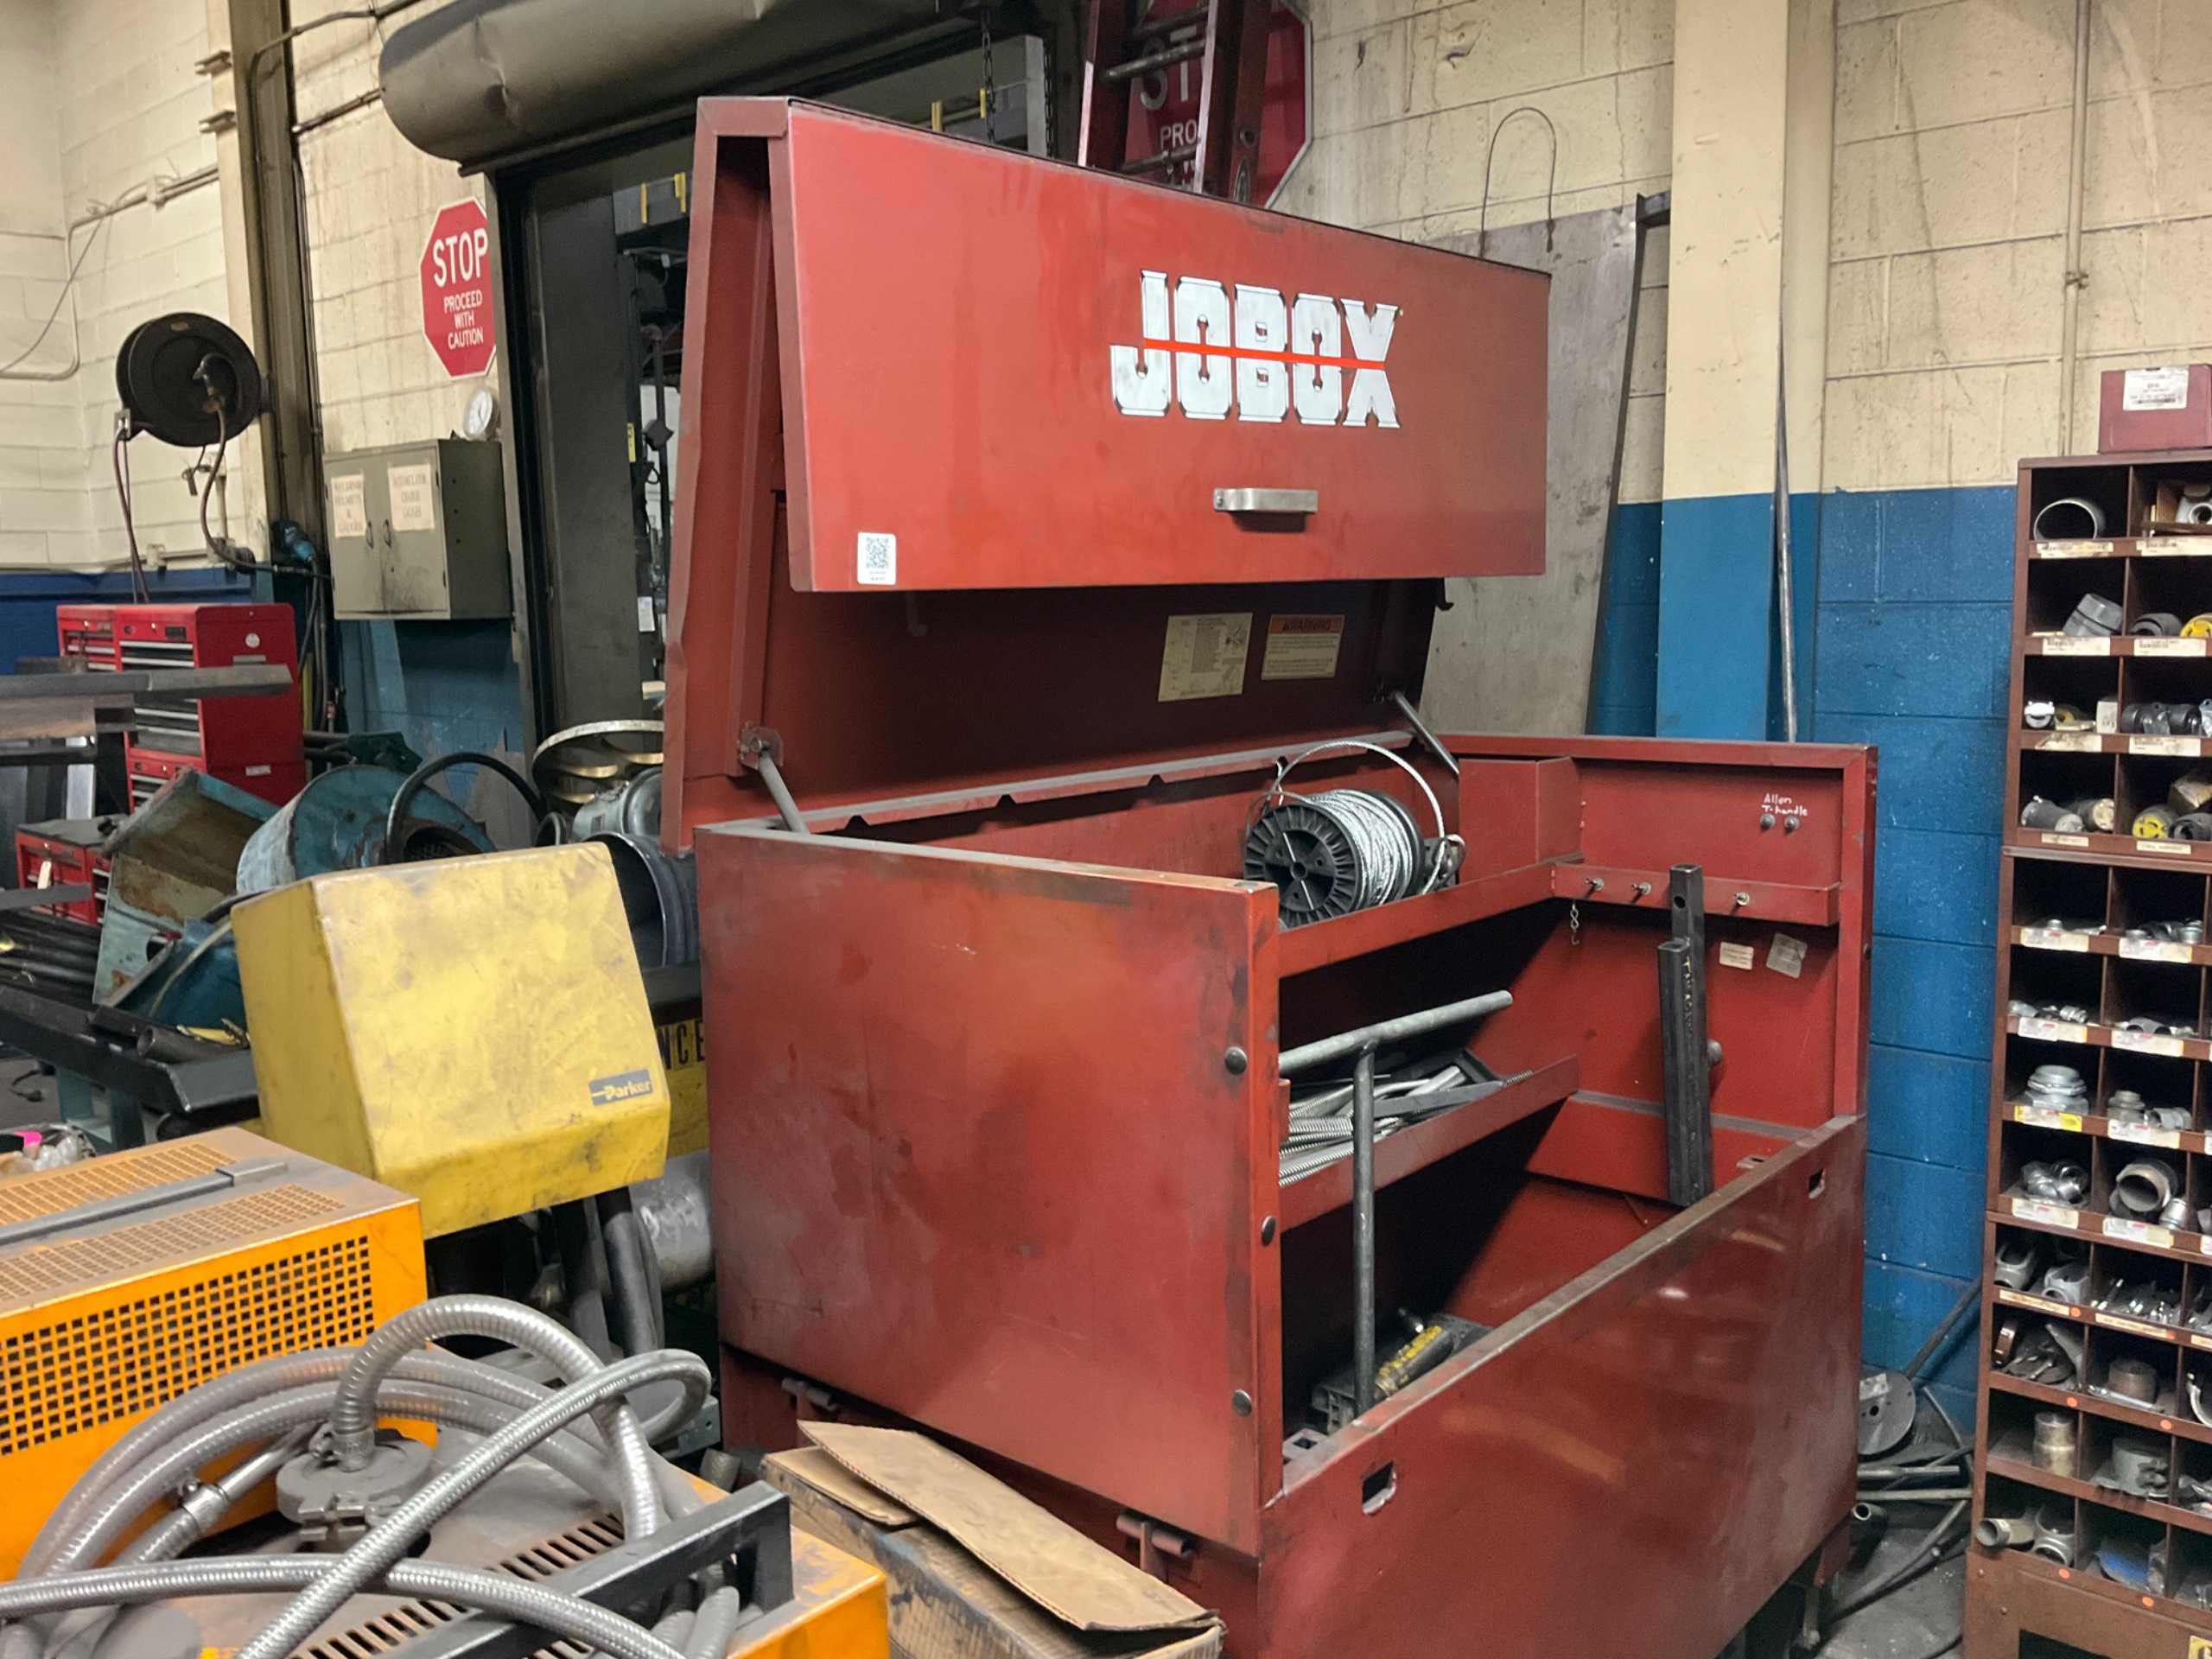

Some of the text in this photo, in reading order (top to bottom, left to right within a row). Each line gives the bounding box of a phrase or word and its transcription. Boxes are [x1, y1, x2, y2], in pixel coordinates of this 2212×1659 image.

[433, 227, 488, 288] STOP
[443, 289, 483, 314] PROCEED
[454, 310, 474, 329] WITH
[448, 327, 484, 350] CAUTION
[1109, 270, 1402, 429] JOBOX
[1764, 793, 1792, 804] Allen
[604, 1080, 651, 1101] Parker
